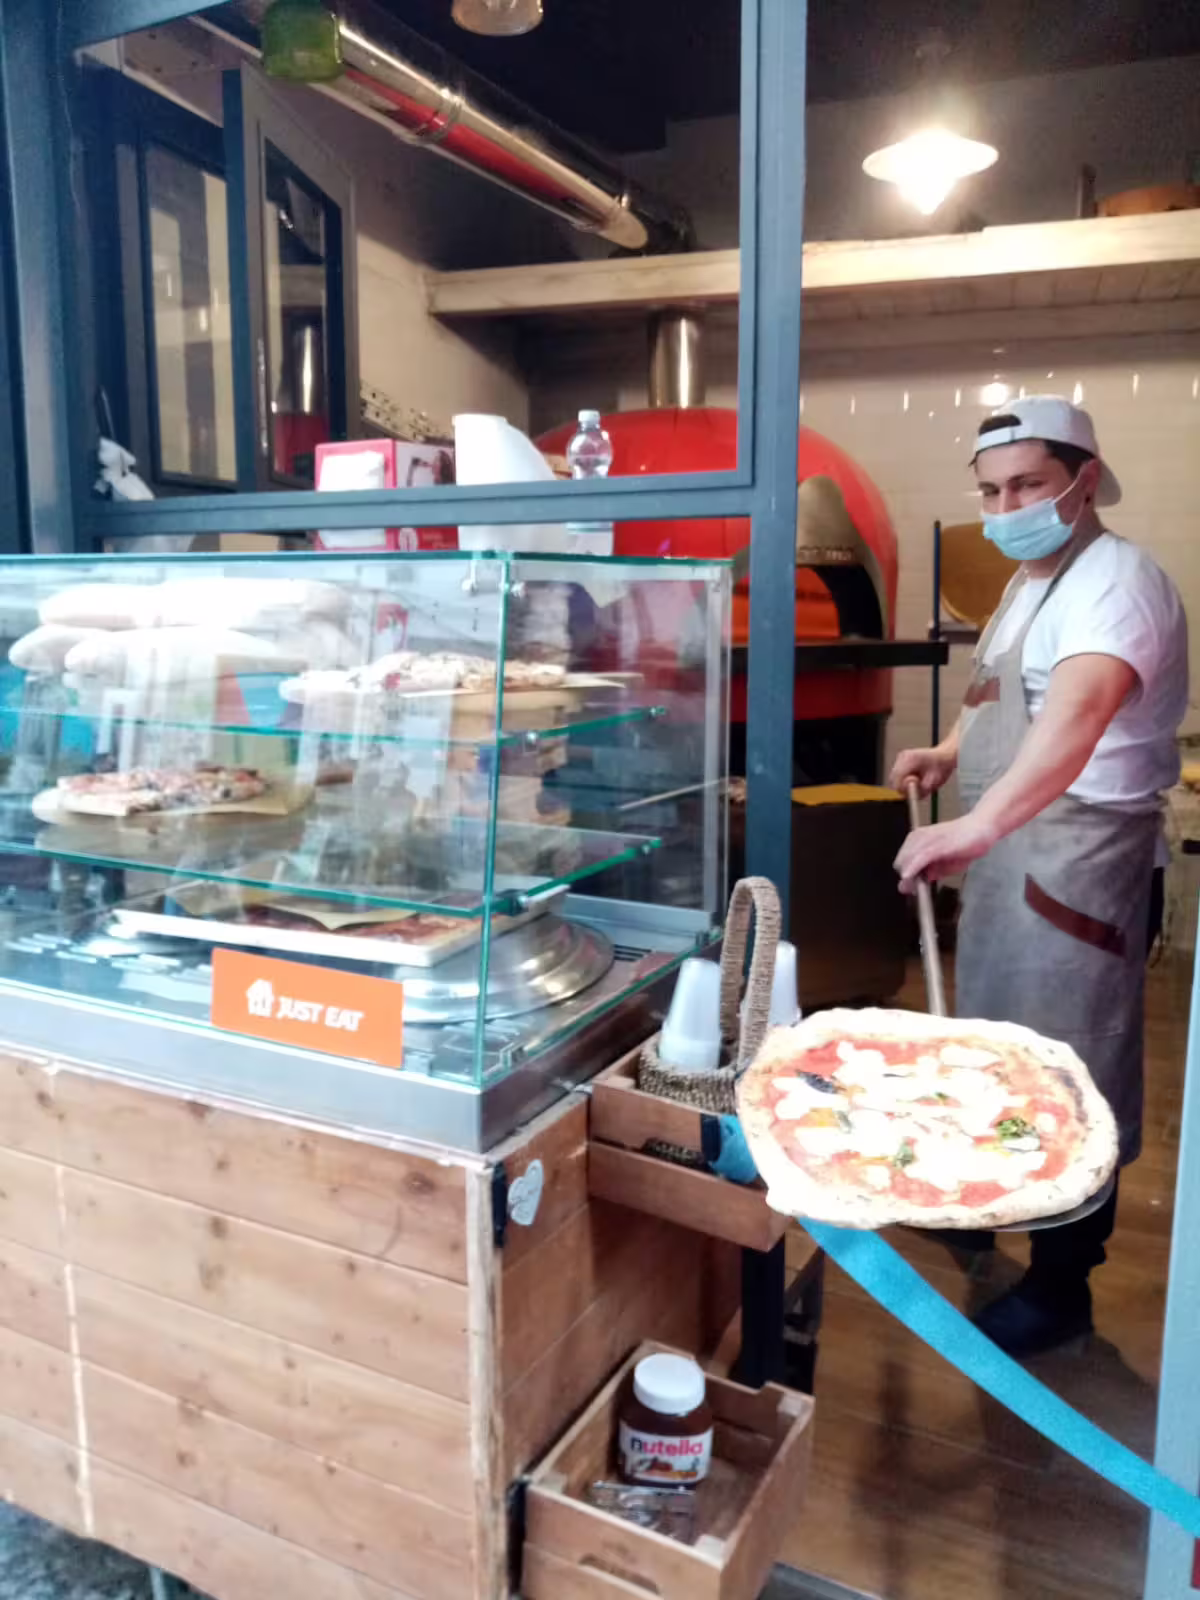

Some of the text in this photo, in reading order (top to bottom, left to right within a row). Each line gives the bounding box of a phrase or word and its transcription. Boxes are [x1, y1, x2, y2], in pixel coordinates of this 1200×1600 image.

[277, 997, 363, 1031] JUST EAT
[631, 1437, 704, 1456] nutella
